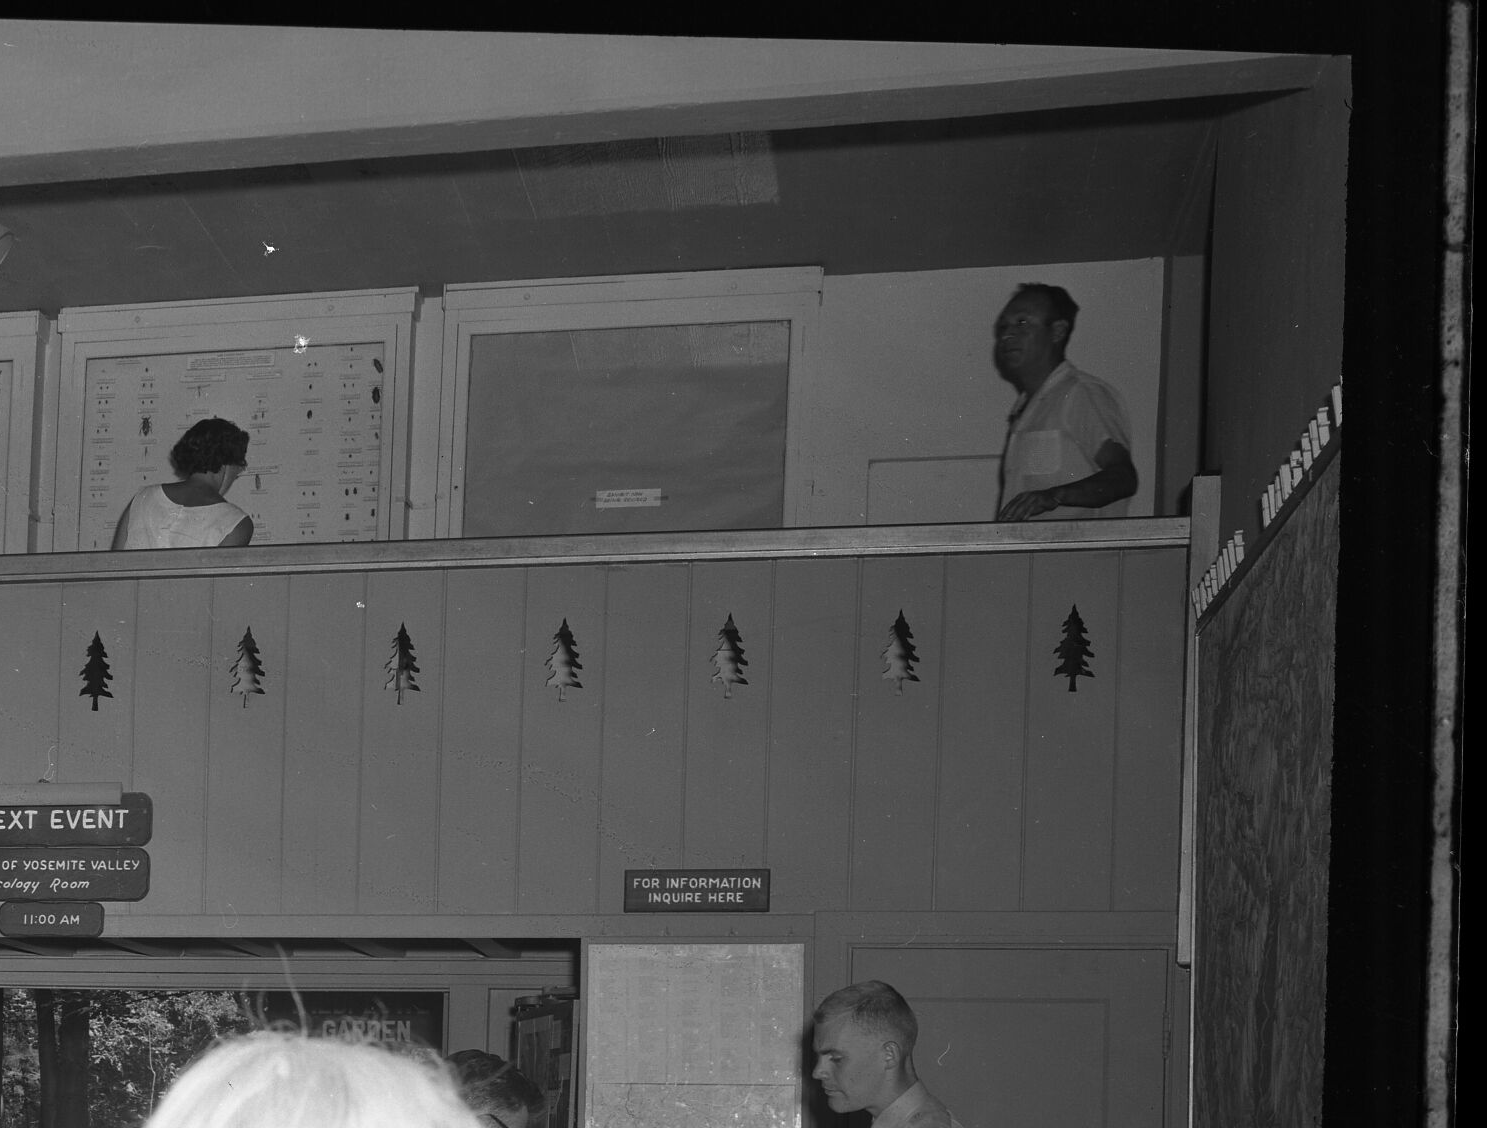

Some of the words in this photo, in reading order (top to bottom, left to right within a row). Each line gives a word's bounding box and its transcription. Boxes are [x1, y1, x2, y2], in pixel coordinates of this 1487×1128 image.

[50, 809, 129, 829] EVENT
[2, 860, 17, 871] OF
[23, 859, 86, 871] YOSEMITE
[91, 859, 140, 871] VALLEY
[49, 878, 90, 893] Room
[633, 878, 660, 889] FOR
[666, 877, 761, 889] INFORMATION
[648, 892, 702, 904] INQUIRE
[708, 892, 744, 903] HERE
[23, 914, 56, 925] 11:00
[59, 914, 80, 925] AM
[322, 1020, 411, 1042] GARDEN
